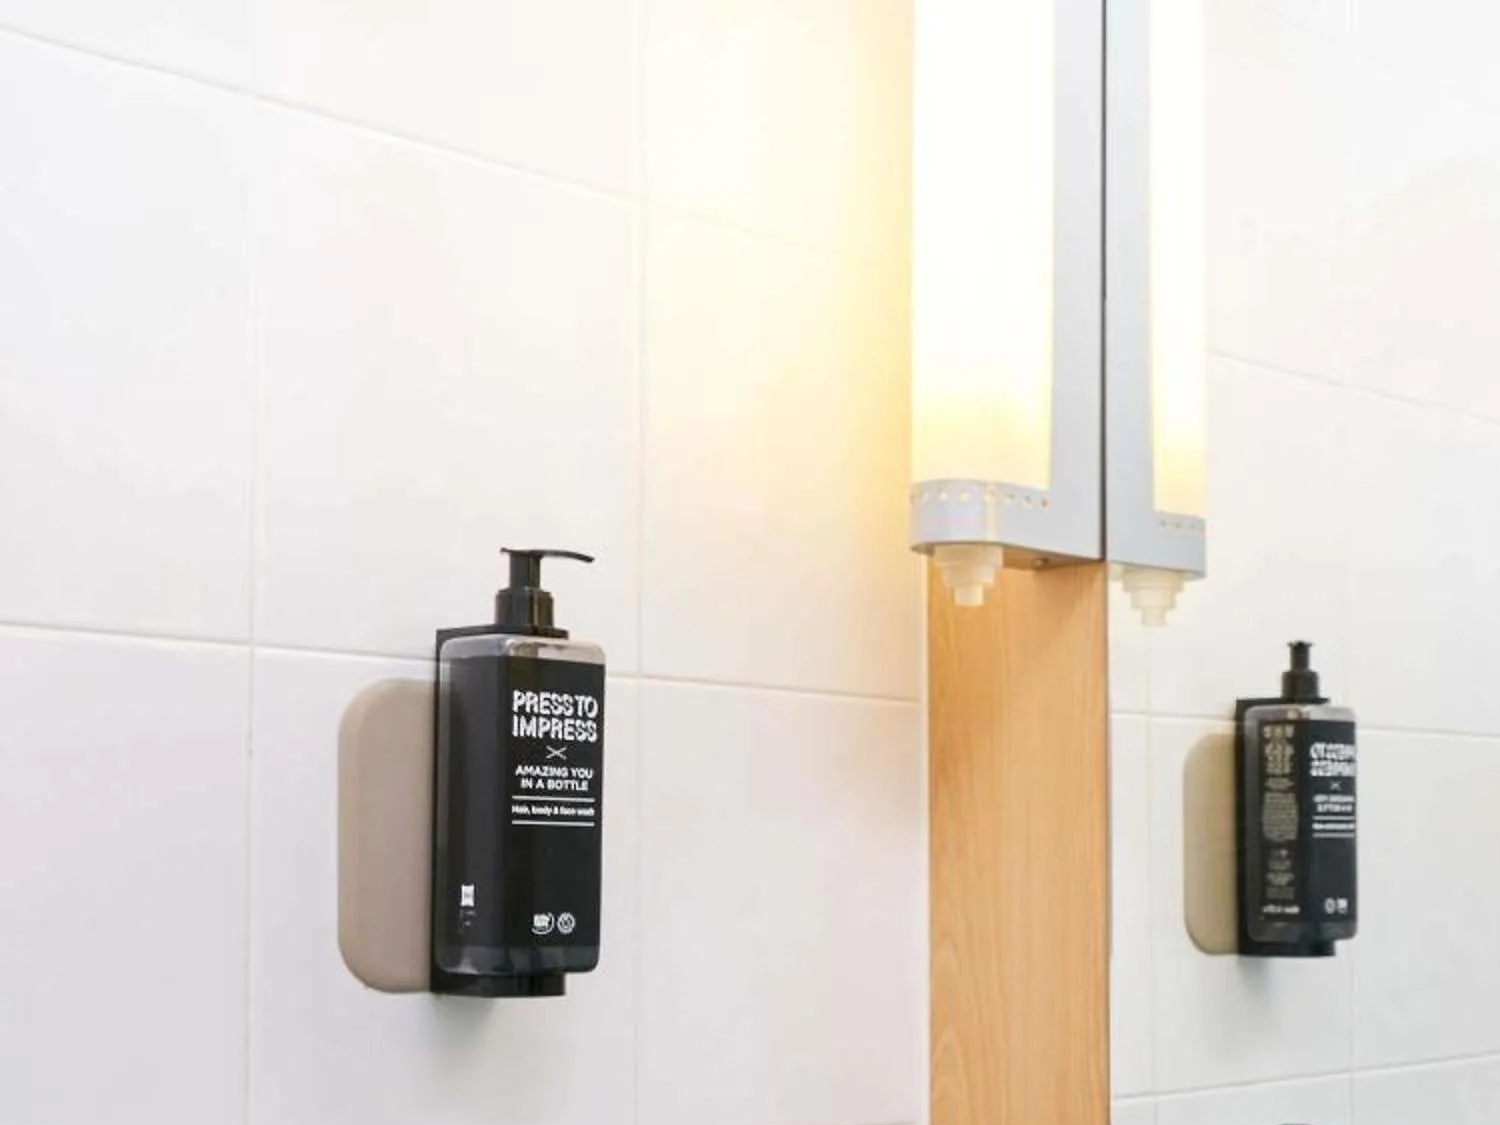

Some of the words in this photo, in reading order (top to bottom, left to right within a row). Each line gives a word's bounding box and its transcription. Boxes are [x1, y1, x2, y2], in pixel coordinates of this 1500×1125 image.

[512, 689, 574, 716] PRESS
[574, 694, 598, 718] TO
[512, 714, 598, 743] IMPRESS
[515, 764, 568, 778] AMAZING
[570, 767, 593, 779] YOU
[535, 779, 545, 789] A
[547, 779, 589, 791] BOTTLE
